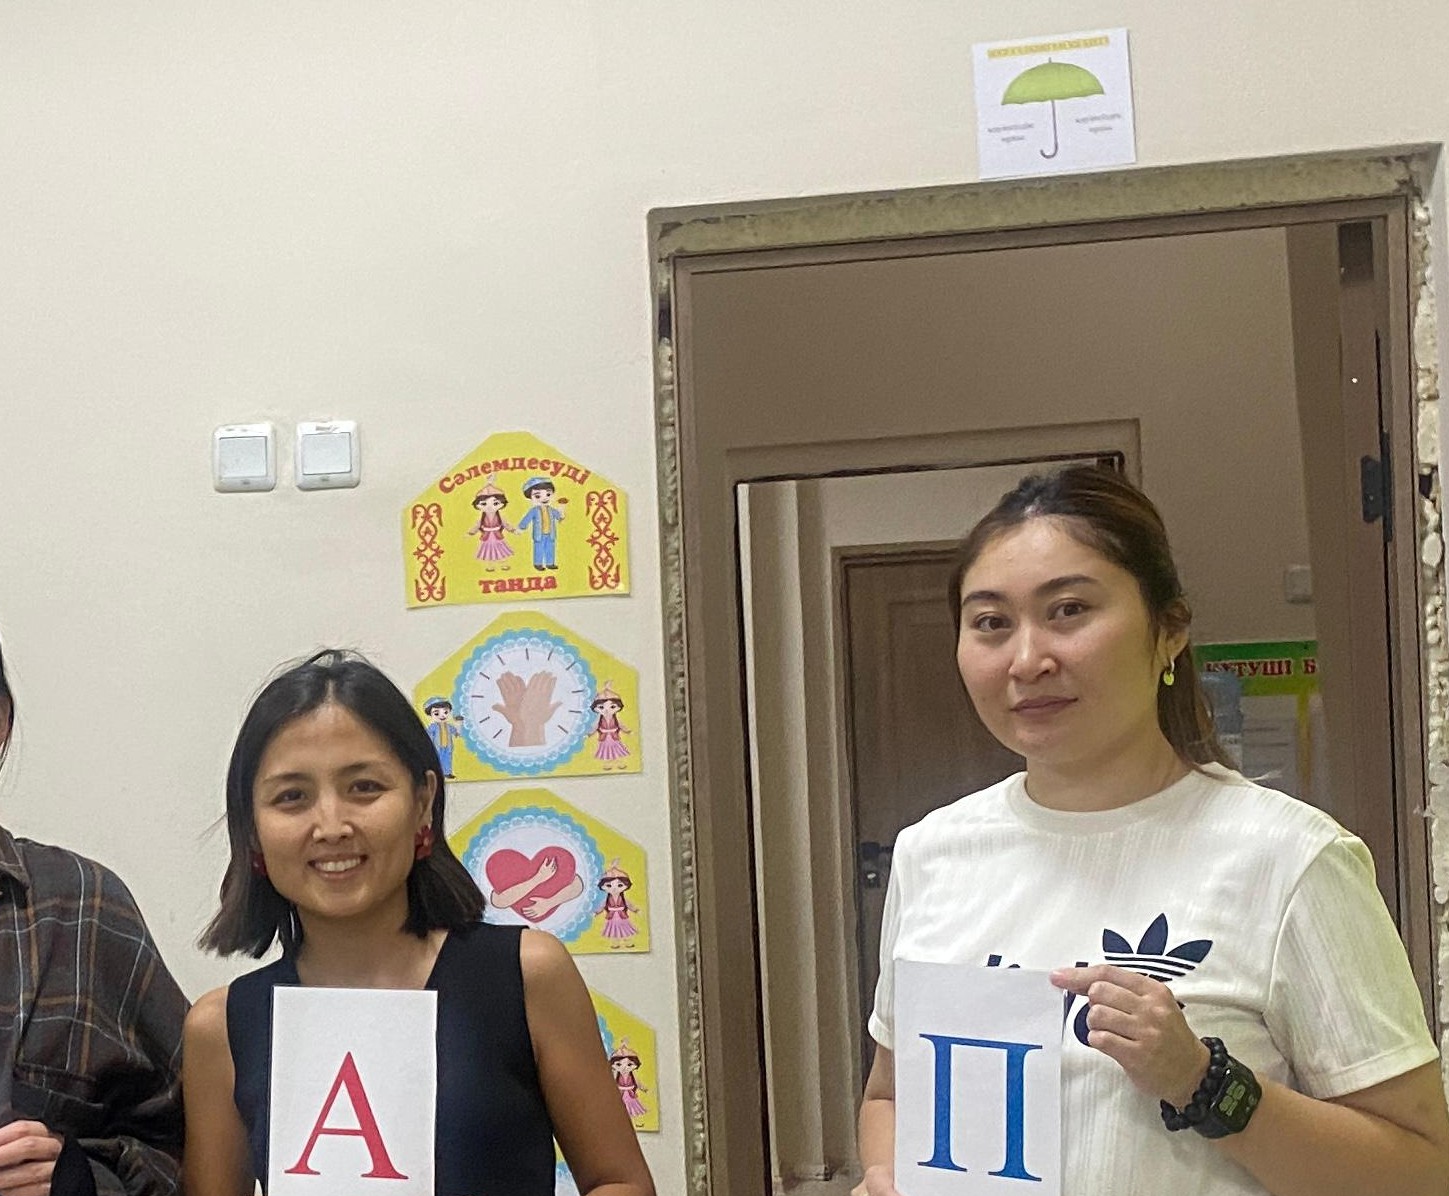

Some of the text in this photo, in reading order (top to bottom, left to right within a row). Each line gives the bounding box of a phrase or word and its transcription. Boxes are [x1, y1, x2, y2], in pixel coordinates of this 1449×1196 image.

[438, 457, 591, 494] Сәлемдесуді
[284, 1051, 409, 1180] А
[917, 1033, 1043, 1182] П
